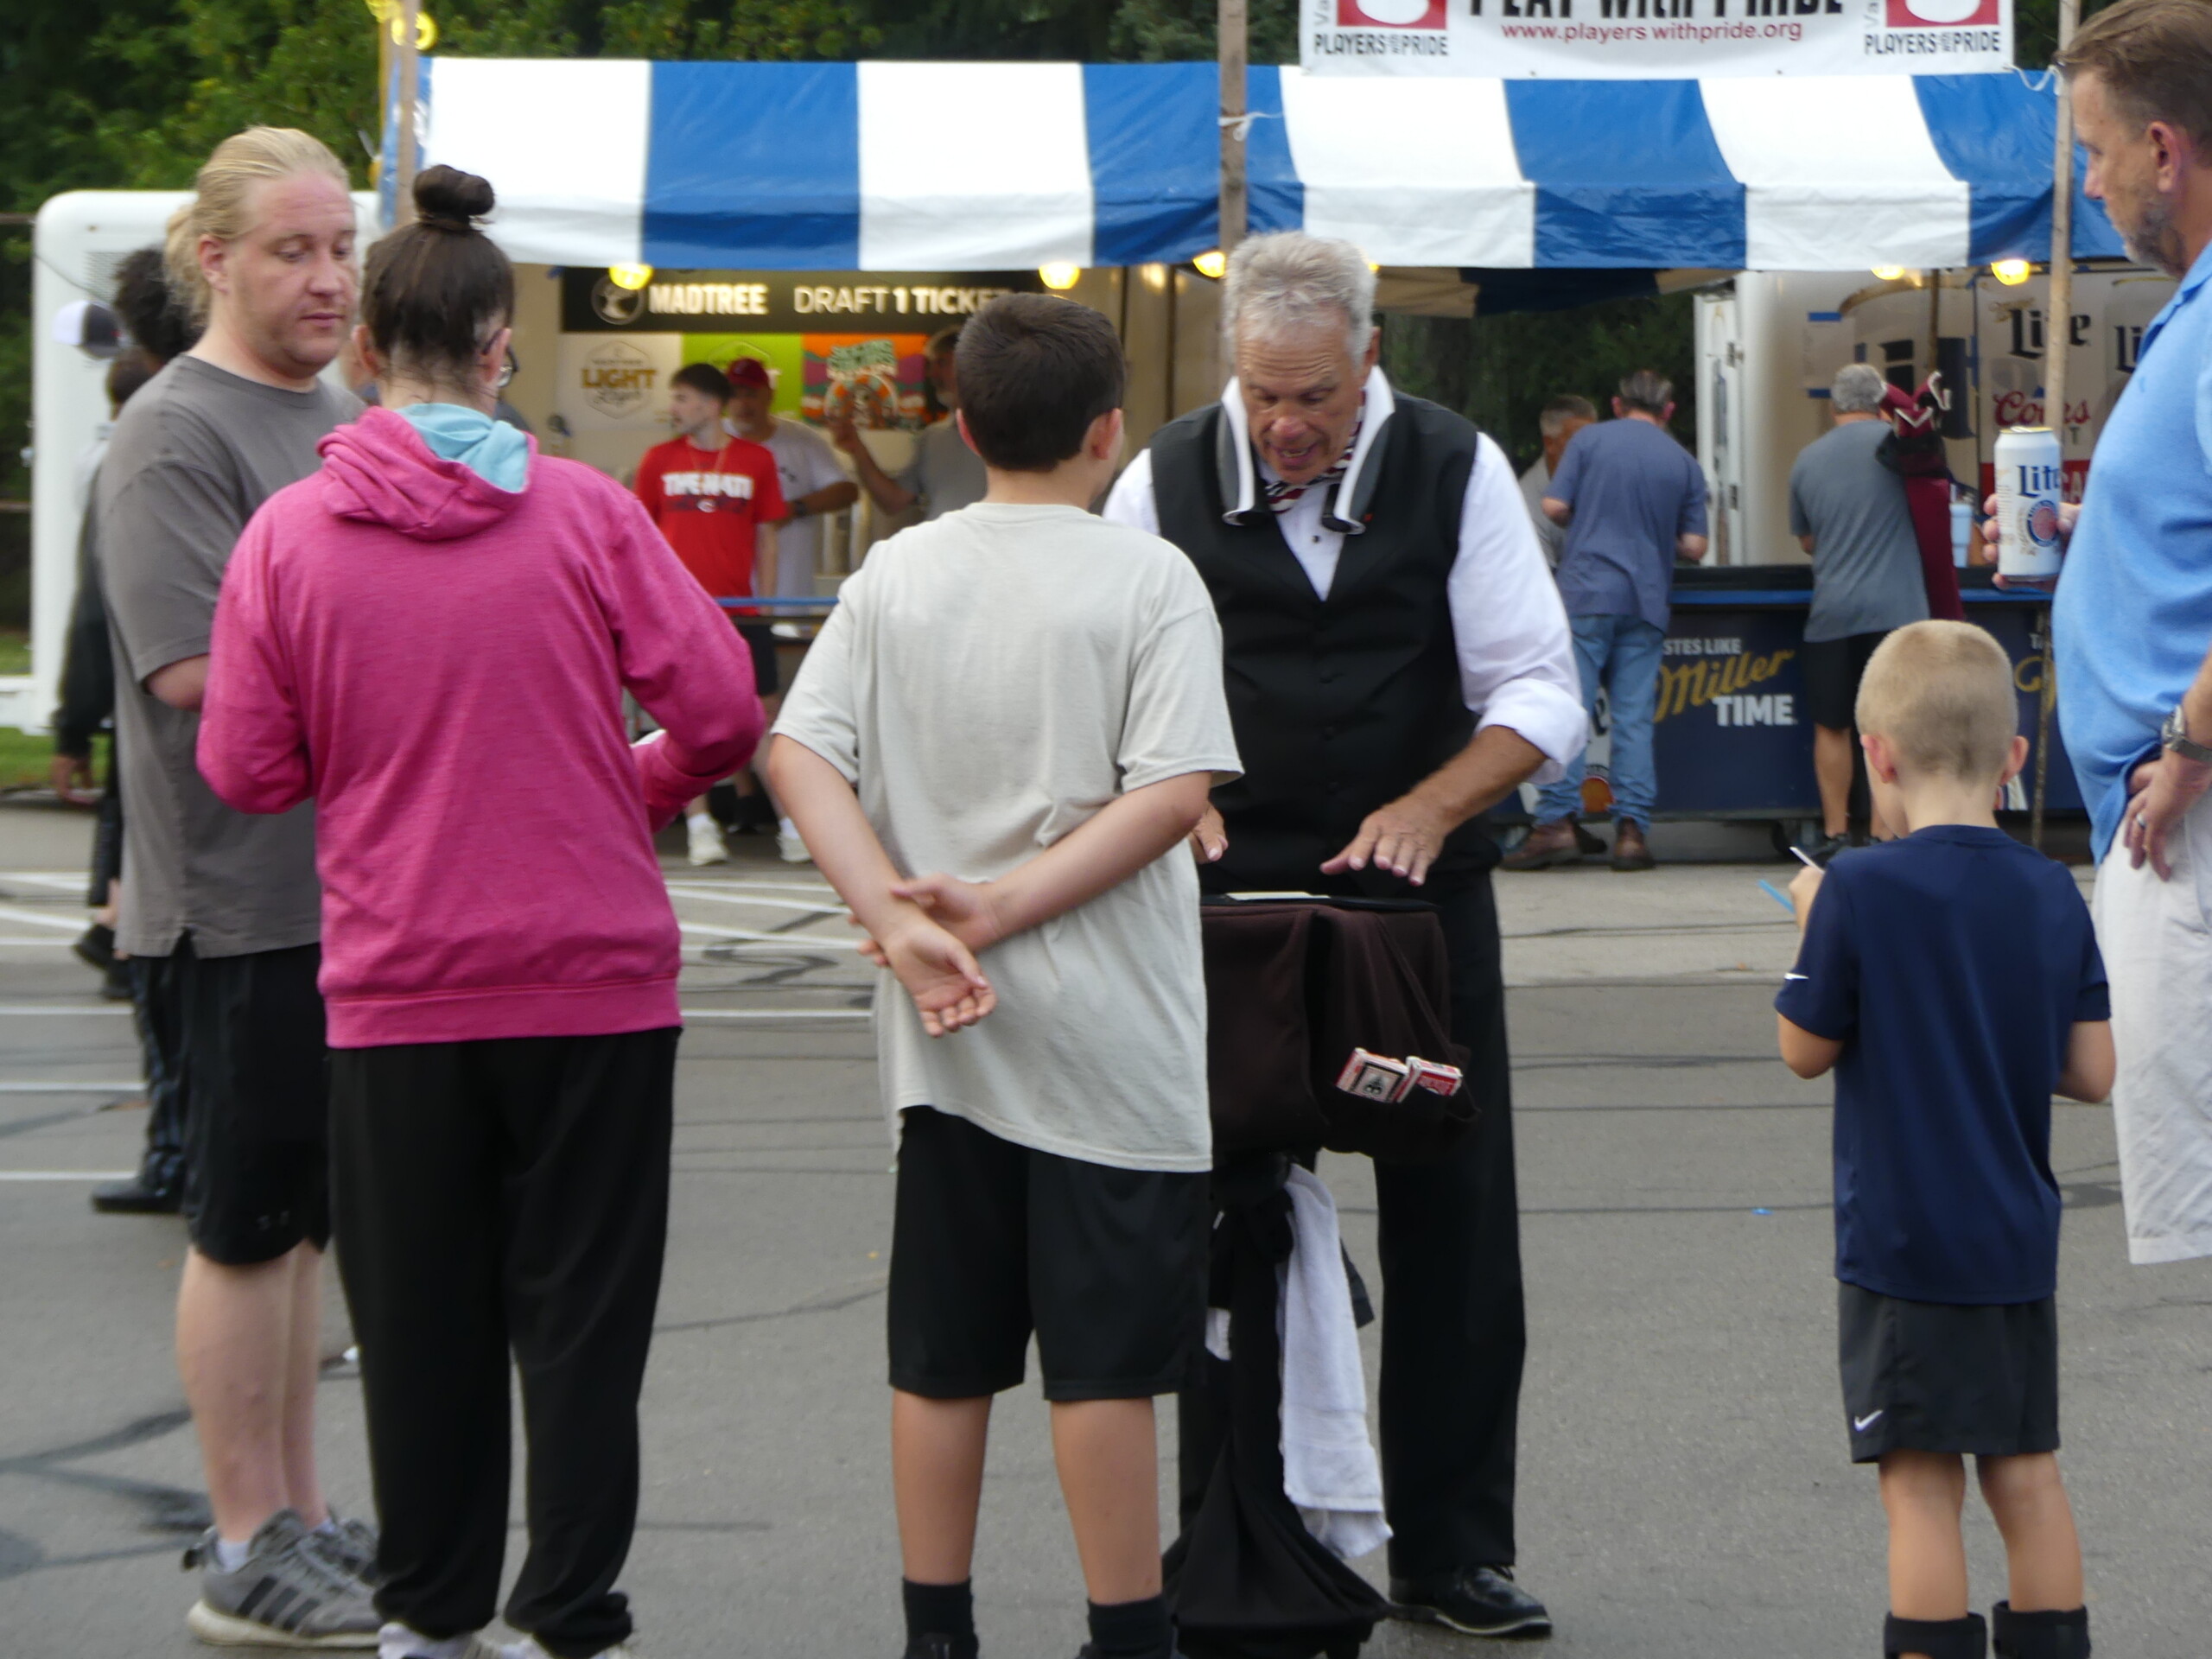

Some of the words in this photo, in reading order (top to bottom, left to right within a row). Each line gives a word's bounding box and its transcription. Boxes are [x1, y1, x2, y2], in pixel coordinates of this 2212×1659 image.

[1314, 34, 1386, 55] PLAYERS
[1402, 35, 1448, 56] PRIDE
[1865, 32, 1937, 54] PLAYERS
[1953, 31, 2001, 53] PRIDE
[649, 283, 769, 315] MADTREE
[794, 286, 888, 314] DRAFT
[892, 287, 909, 315] 1
[2009, 308, 2092, 359] Lie
[581, 368, 658, 388] LIGHT
[1706, 637, 1742, 656] LIKE
[1653, 651, 1796, 723] Miller
